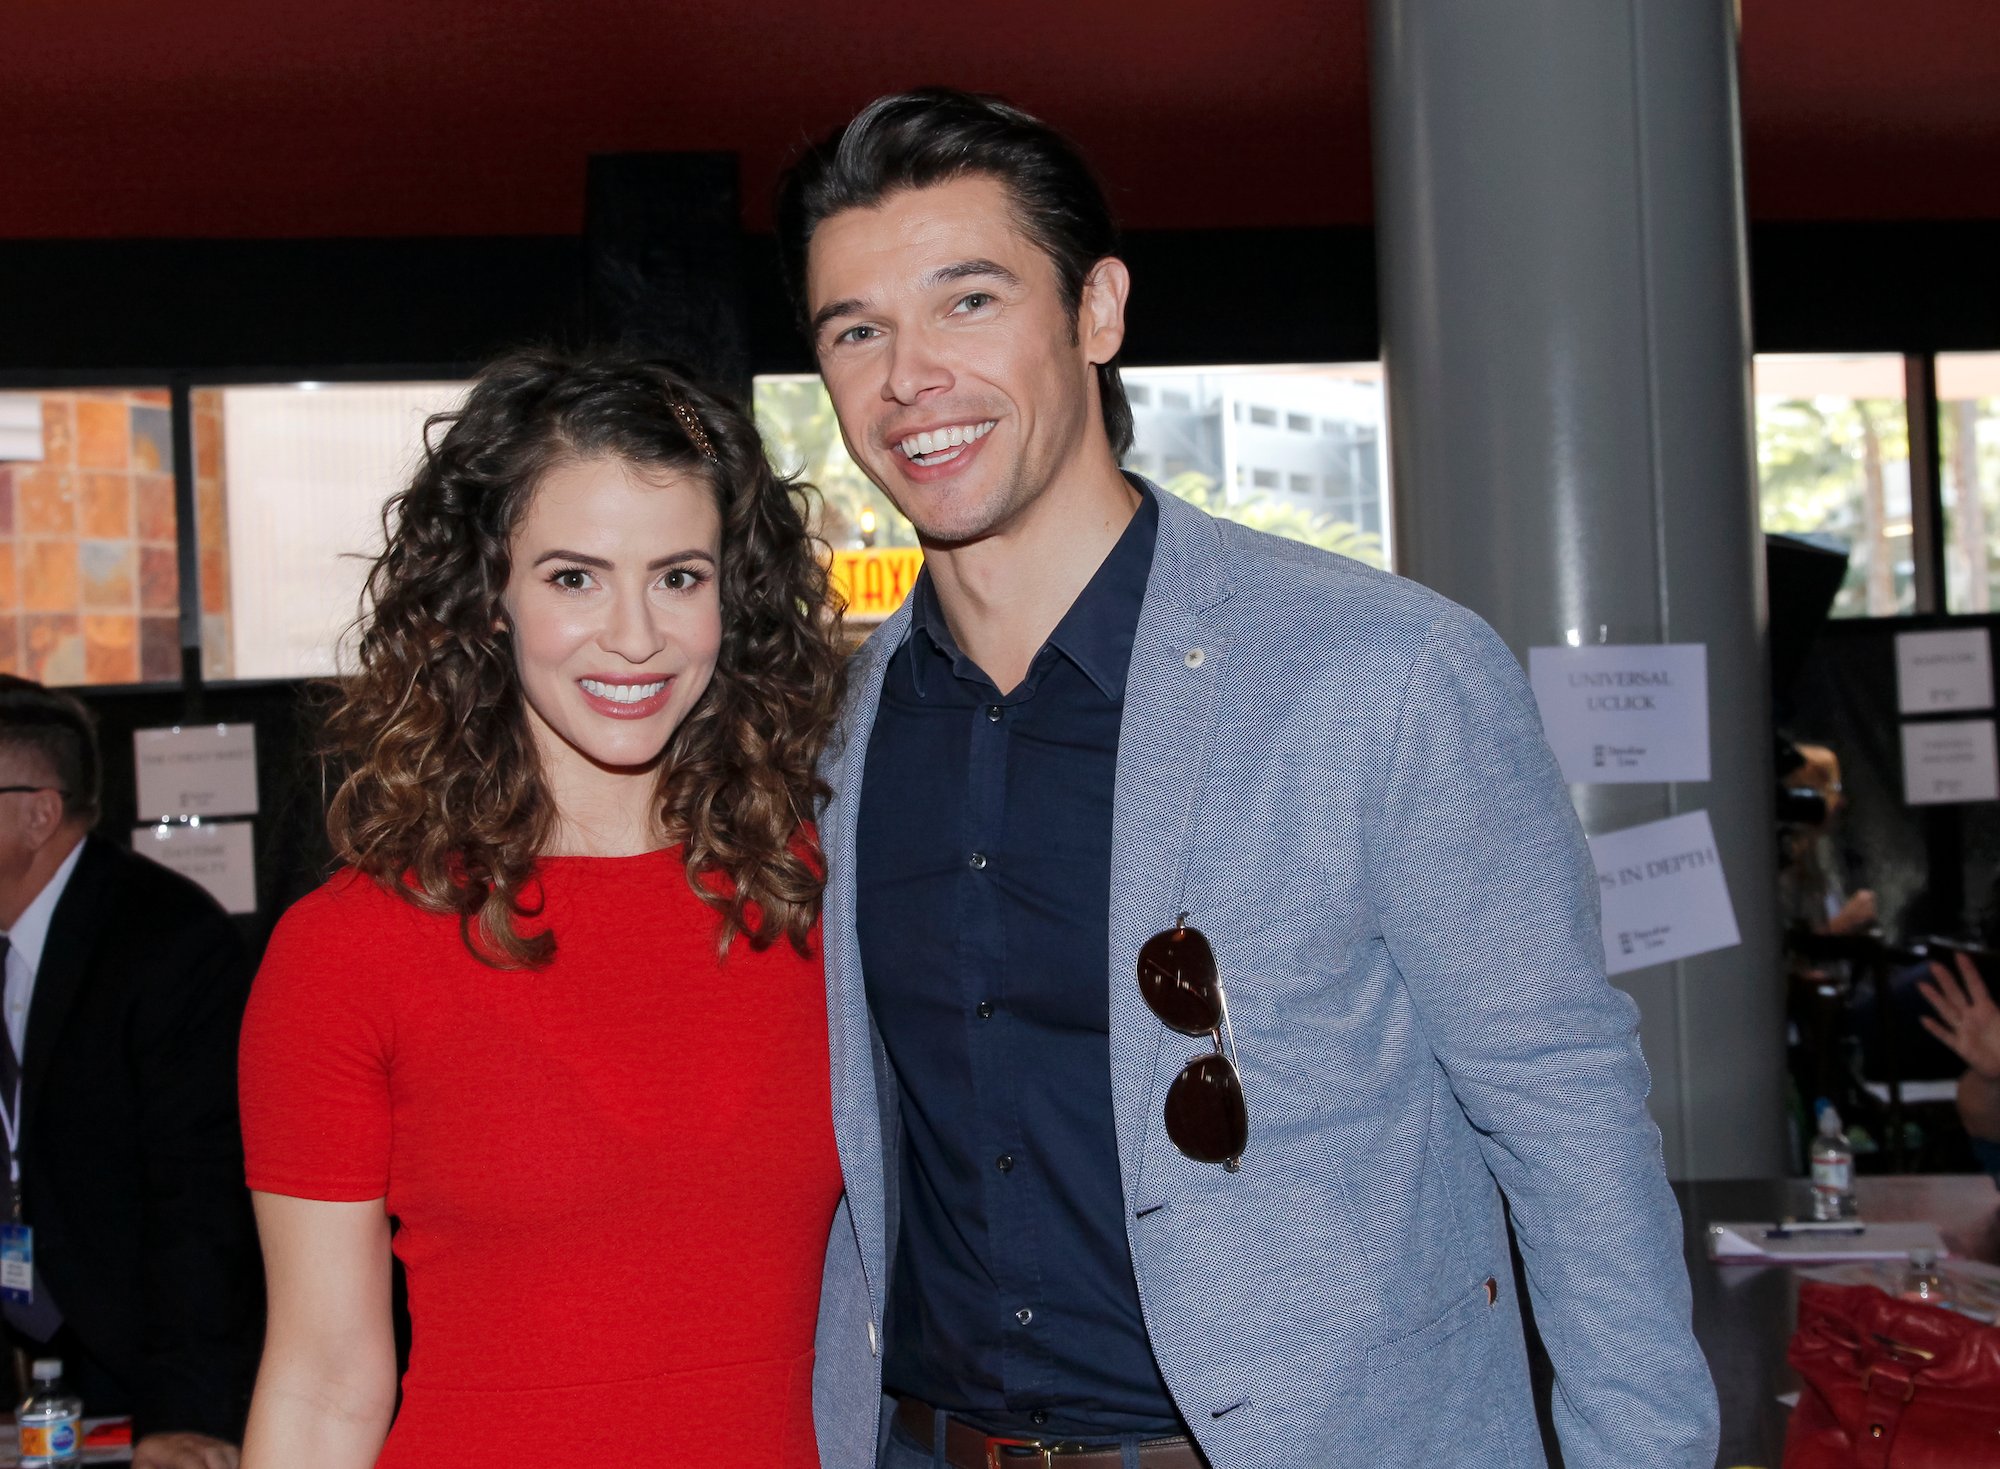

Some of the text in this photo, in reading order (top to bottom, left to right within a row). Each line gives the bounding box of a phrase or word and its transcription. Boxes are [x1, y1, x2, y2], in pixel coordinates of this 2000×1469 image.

[1568, 670, 1674, 688] UNIVERSAL
[1586, 694, 1656, 711] UCLICK
[1618, 865, 1643, 886] IN
[1645, 846, 1715, 879] DEPTH
